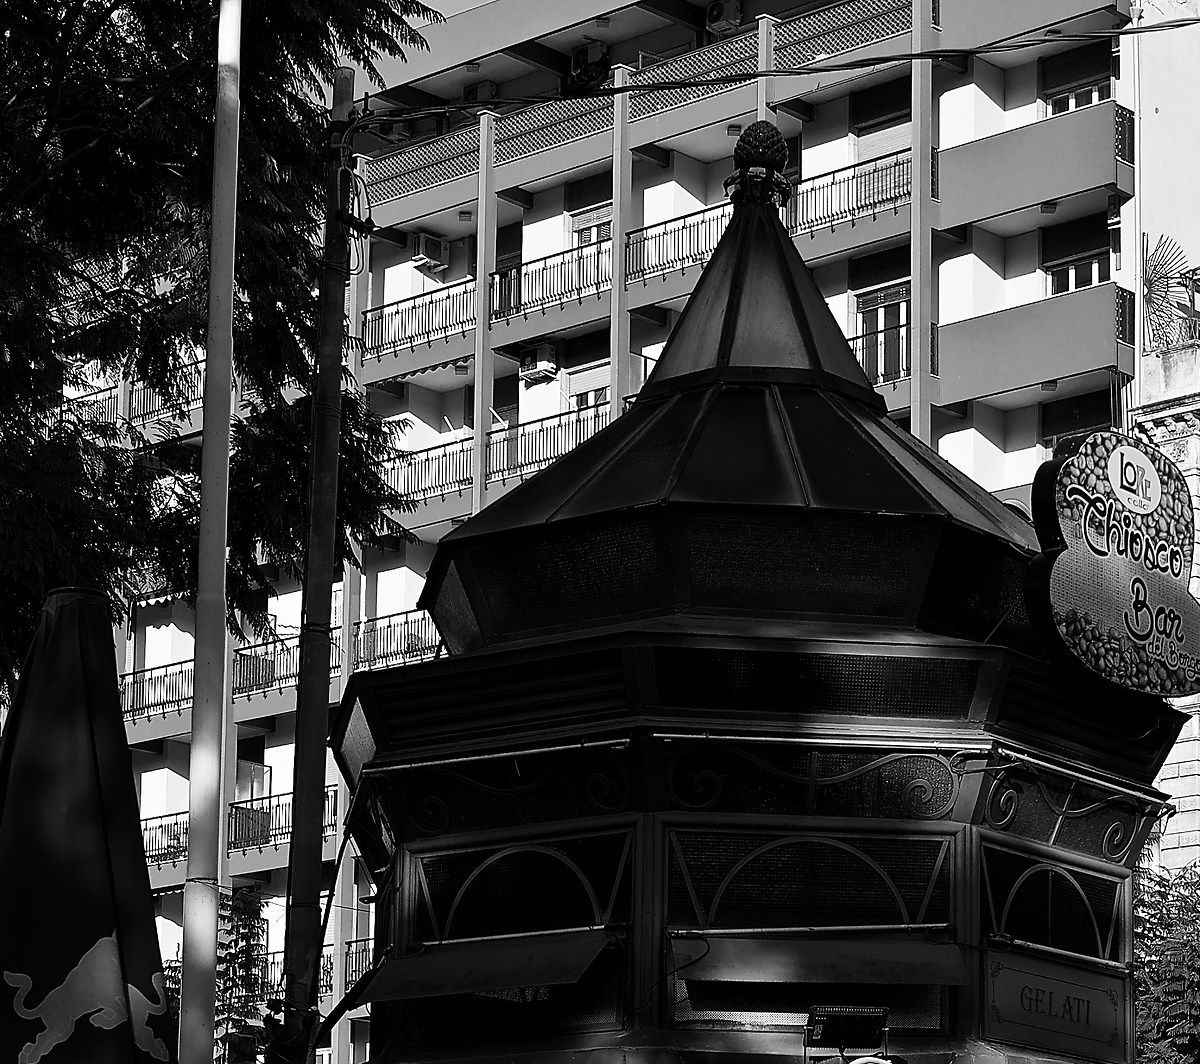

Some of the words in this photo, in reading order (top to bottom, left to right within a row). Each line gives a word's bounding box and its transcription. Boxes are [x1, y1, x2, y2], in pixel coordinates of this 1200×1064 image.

[1066, 484, 1184, 577] Chiosco
[1123, 577, 1184, 645] Bar
[1020, 985, 1091, 1026] GELATI
